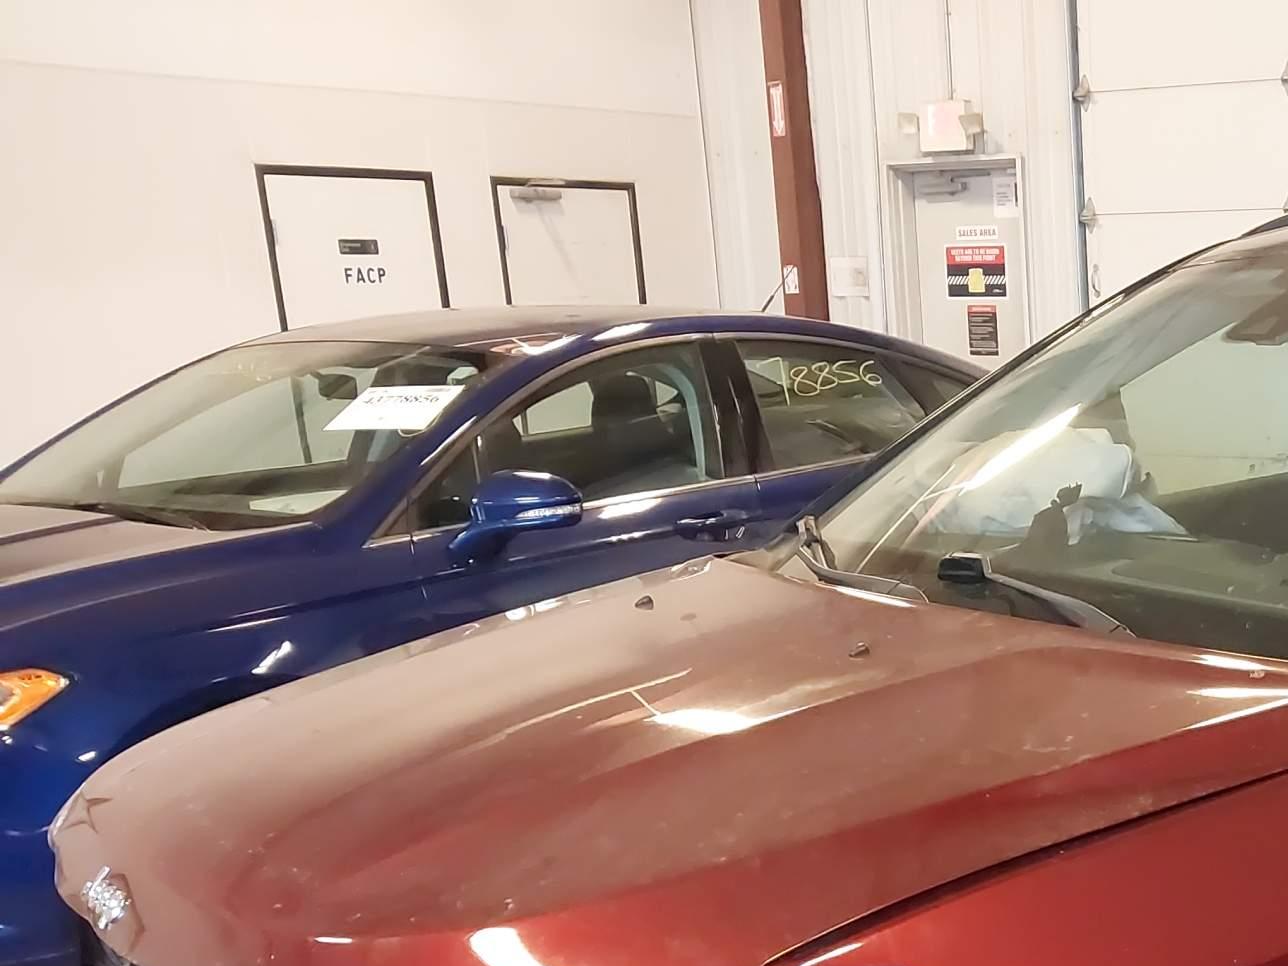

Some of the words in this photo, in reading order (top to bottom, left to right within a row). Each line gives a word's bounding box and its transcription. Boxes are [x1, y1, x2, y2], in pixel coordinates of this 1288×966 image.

[958, 229, 978, 237] SALES
[979, 228, 996, 236] AREA
[344, 267, 386, 284] FACP
[756, 356, 882, 407] 78856
